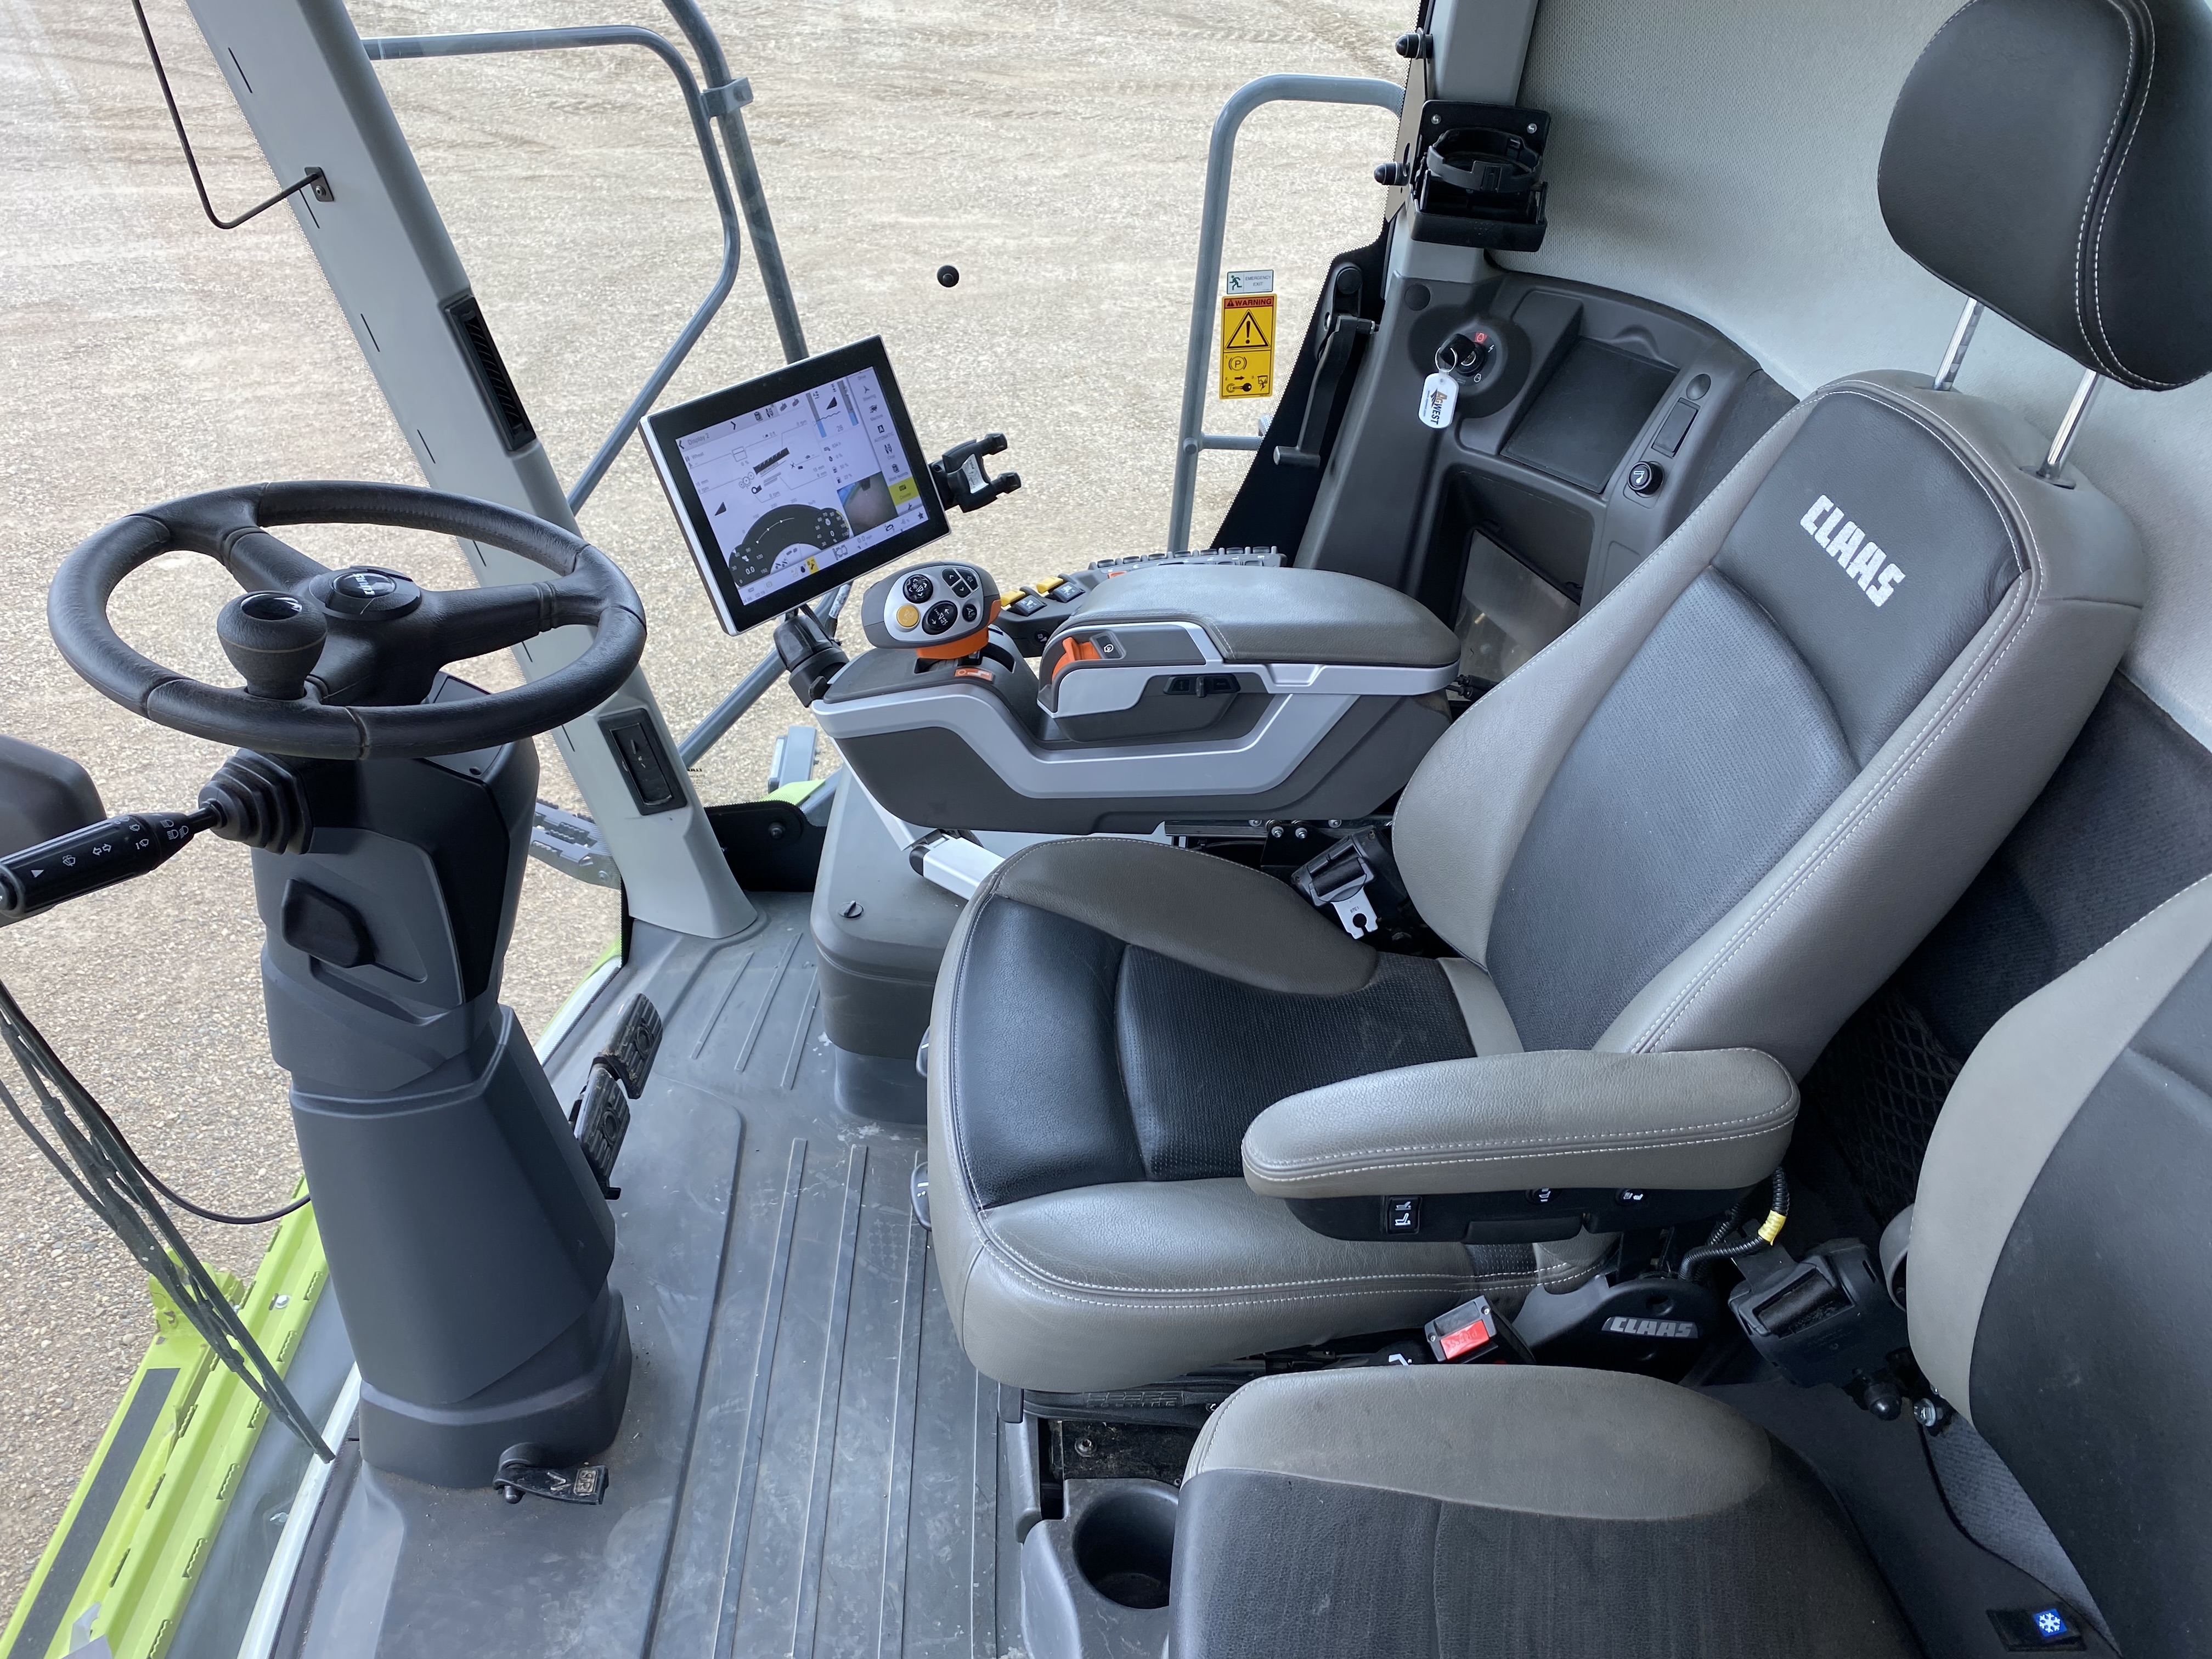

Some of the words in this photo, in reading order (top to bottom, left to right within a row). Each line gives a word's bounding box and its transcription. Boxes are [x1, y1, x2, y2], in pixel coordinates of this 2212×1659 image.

[687, 435, 706, 446] Display
[1800, 494, 1906, 607] CLAAS
[745, 566, 755, 575] 0.0
[1610, 1317, 1693, 1337] CLAAS
